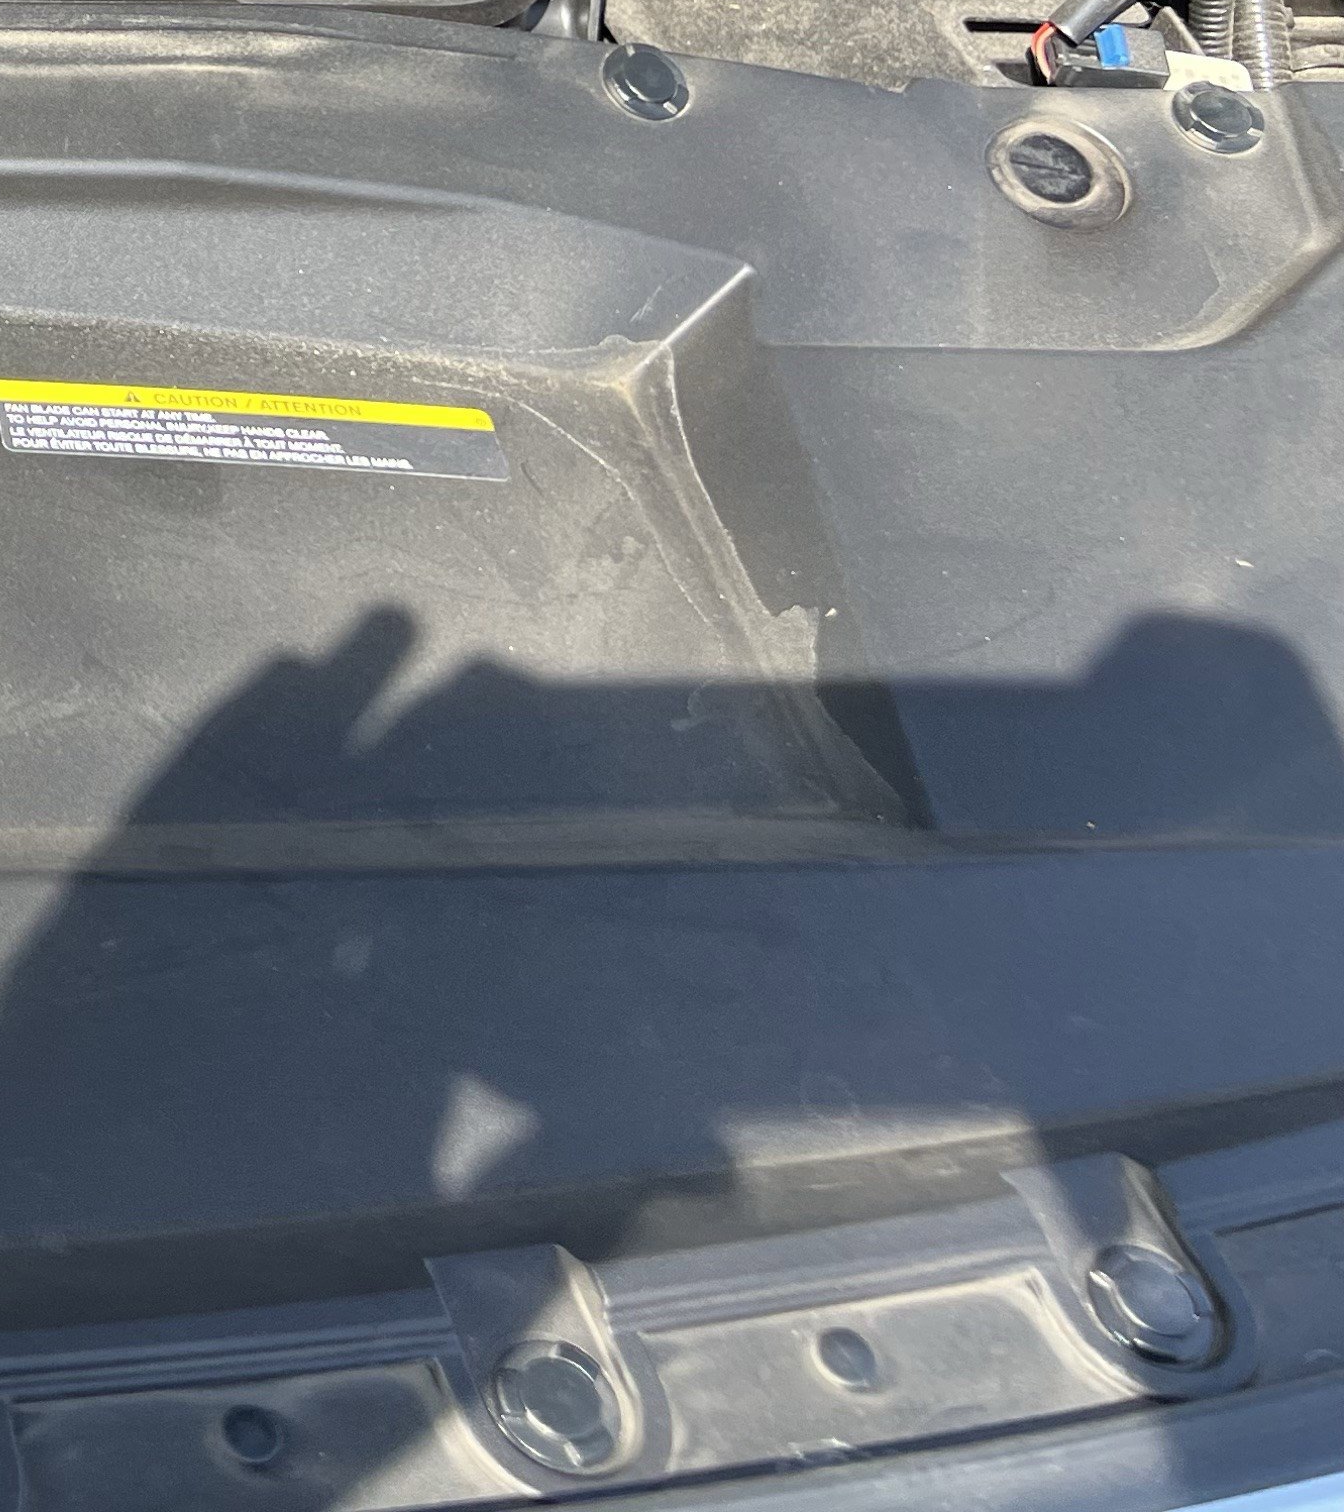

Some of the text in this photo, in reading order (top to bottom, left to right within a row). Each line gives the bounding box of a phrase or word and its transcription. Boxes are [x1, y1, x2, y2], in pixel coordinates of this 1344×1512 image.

[4, 403, 29, 413] FAN
[30, 404, 71, 415] BLADE
[72, 406, 100, 416] CAN
[101, 407, 139, 418] START
[140, 409, 155, 418] AT
[157, 410, 183, 420] ANY
[153, 392, 238, 409] CAUTION
[260, 399, 362, 416] ATTENTION
[6, 413, 25, 423] TO
[26, 414, 58, 425] HELP
[60, 416, 98, 427] AVOID
[99, 418, 166, 431] PERSONAL
[240, 425, 285, 437] HANDS
[9, 426, 26, 436] LE
[27, 427, 107, 440] VENTILATEUR
[107, 430, 155, 442] RISQUE
[155, 433, 173, 443] DE
[253, 437, 287, 449] TOUT
[11, 437, 49, 448] POUR
[50, 436, 93, 450] ÉVITER
[93, 441, 135, 453] TOUTE
[203, 446, 223, 457] NE
[222, 447, 249, 459] PAS
[249, 448, 269, 460] EN
[268, 450, 347, 465] APPROCHER
[346, 454, 370, 466] LES
